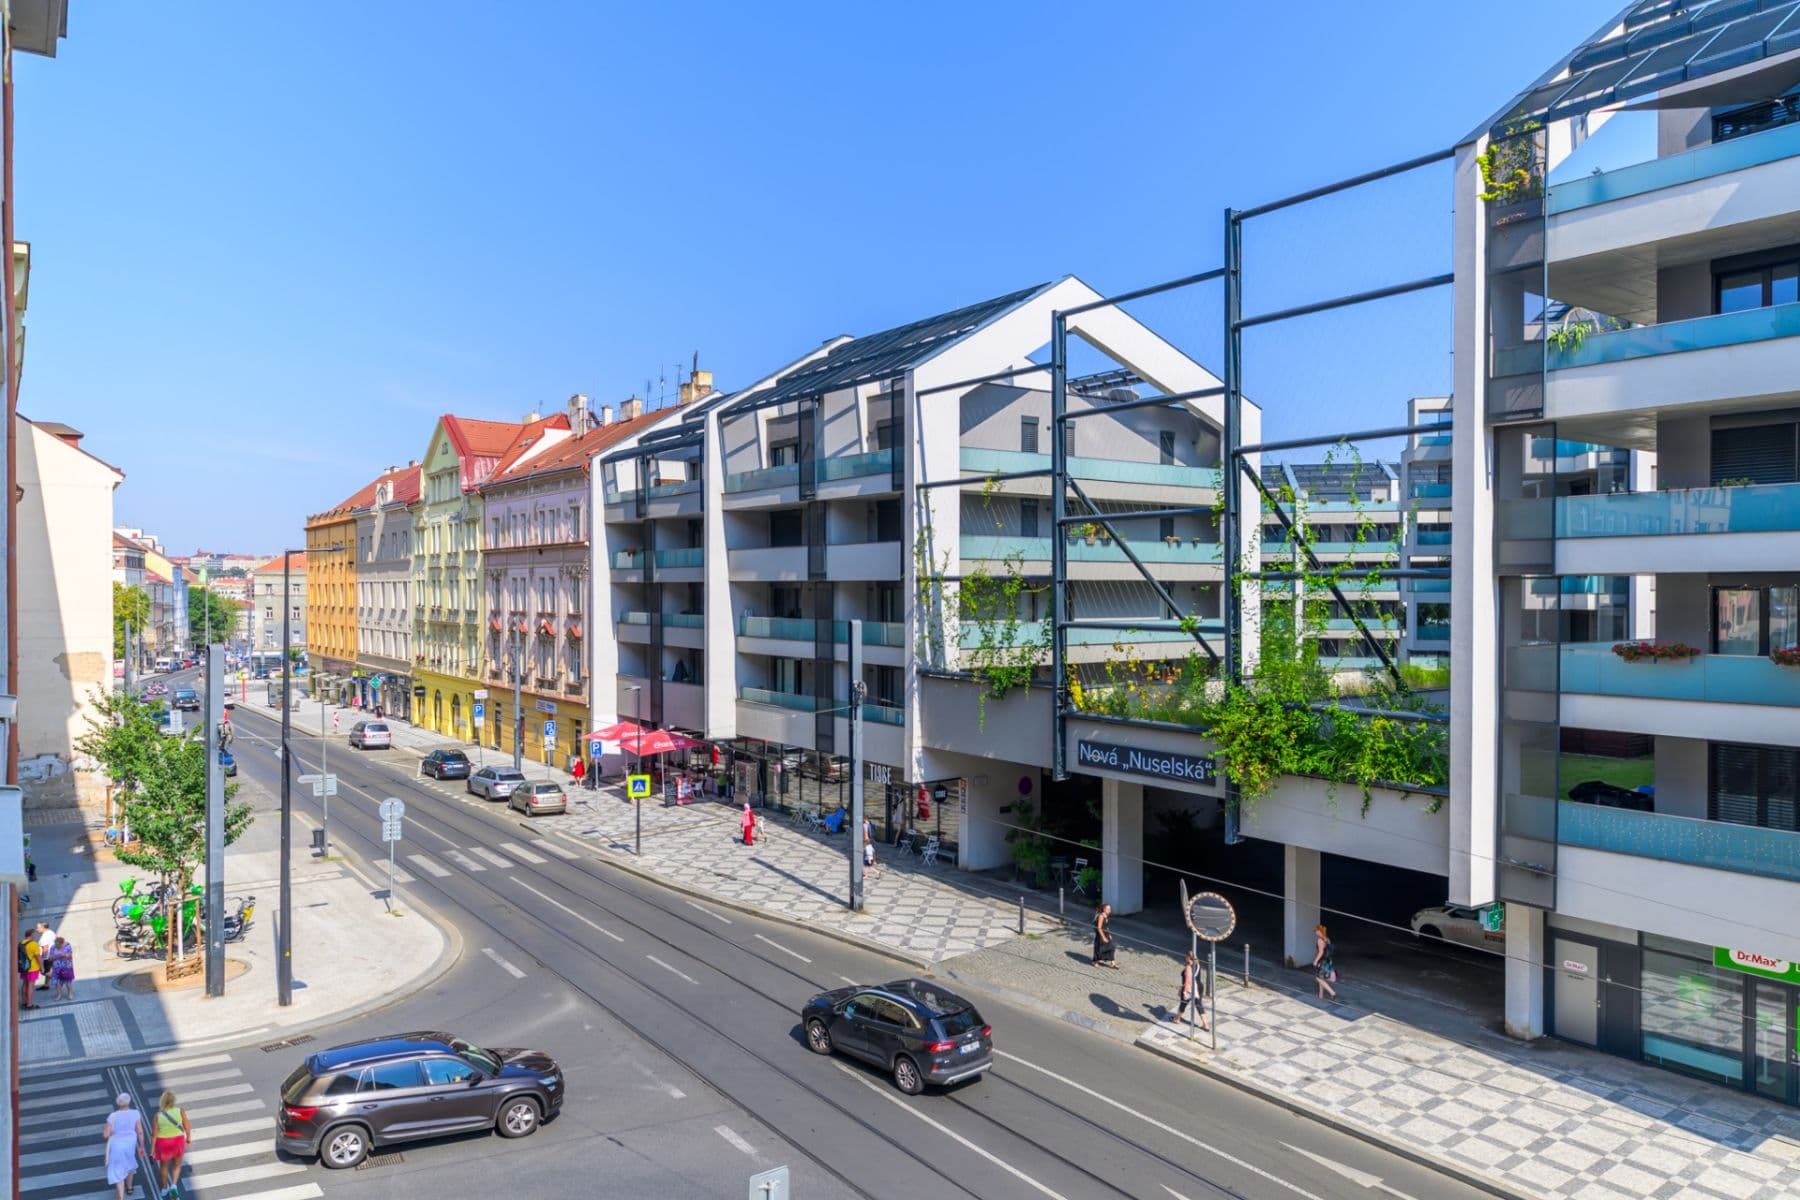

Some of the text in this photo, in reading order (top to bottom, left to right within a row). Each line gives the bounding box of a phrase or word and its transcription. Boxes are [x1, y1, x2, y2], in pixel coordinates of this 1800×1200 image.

[592, 742, 600, 752] P
[1080, 743, 1118, 766] Nová
[1737, 950, 1777, 968] Dr.Max
